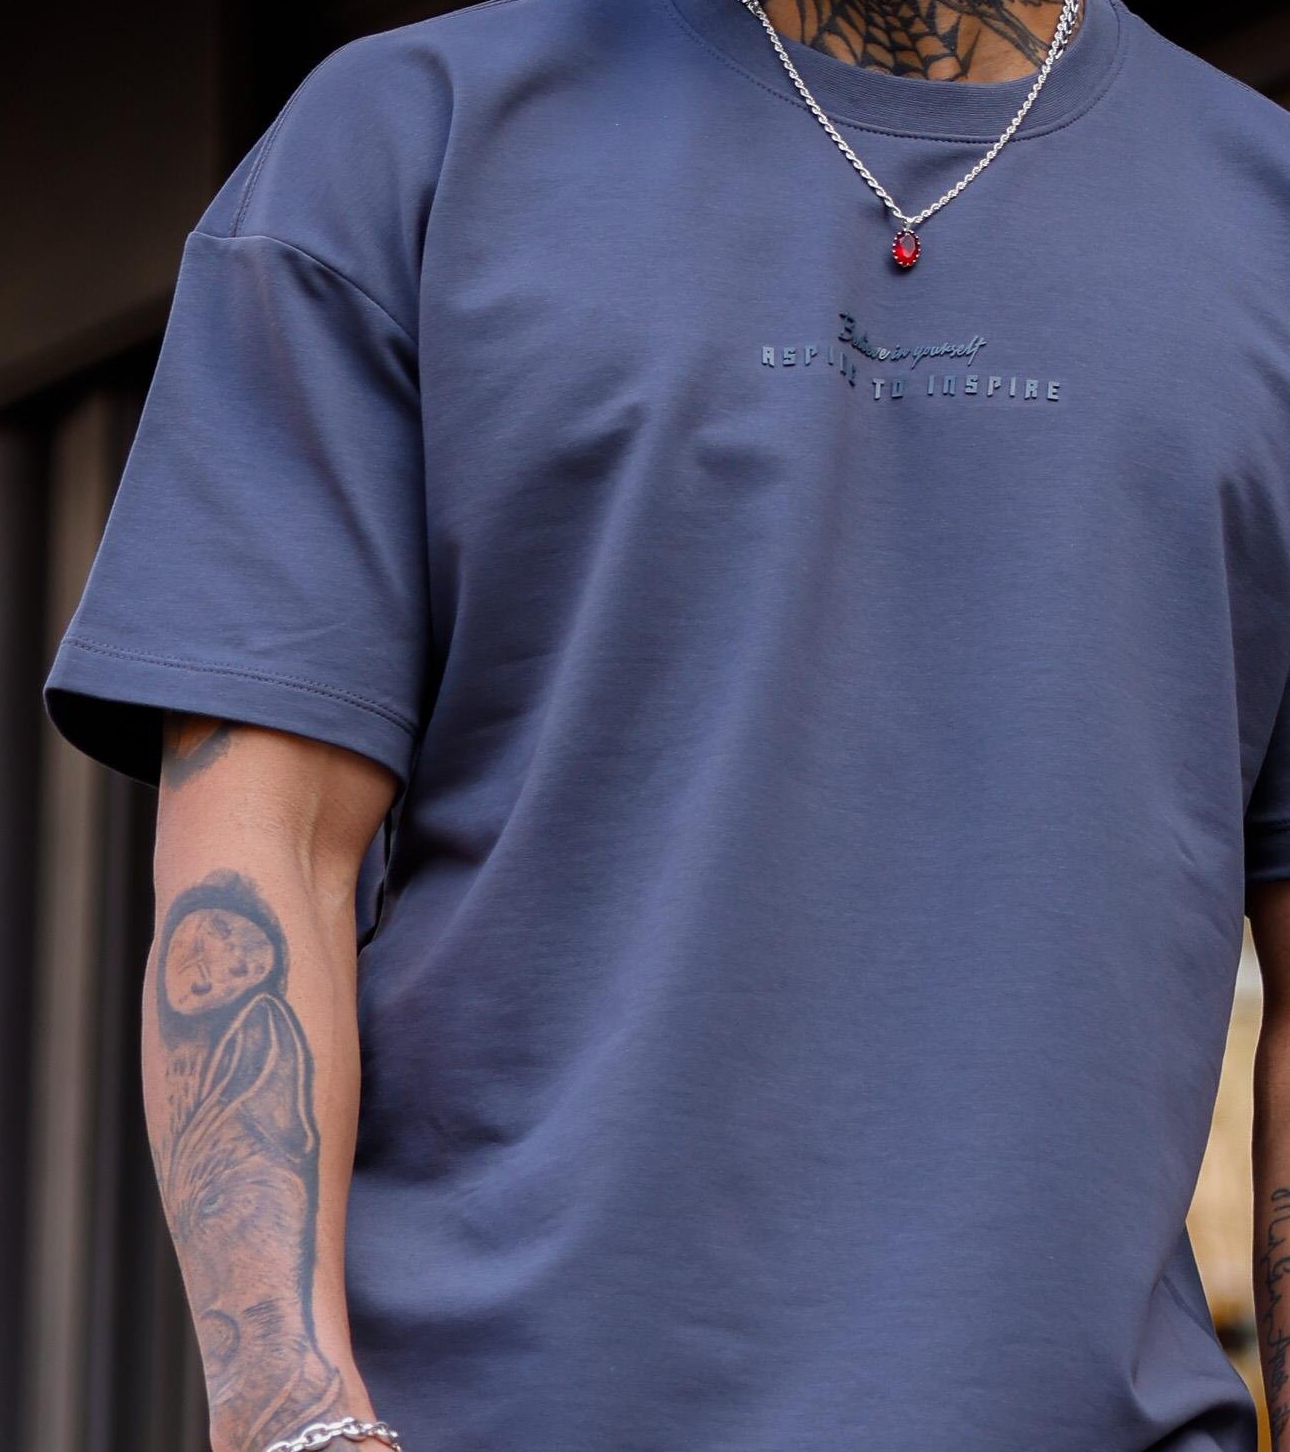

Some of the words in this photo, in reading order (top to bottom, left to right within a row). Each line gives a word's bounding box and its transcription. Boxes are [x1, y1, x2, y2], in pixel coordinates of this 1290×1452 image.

[762, 346, 856, 388] ASPI
[872, 377, 906, 401] TO
[927, 374, 1061, 401] INSPIRE
[891, 345, 911, 361] in
[911, 335, 987, 370] yourself
